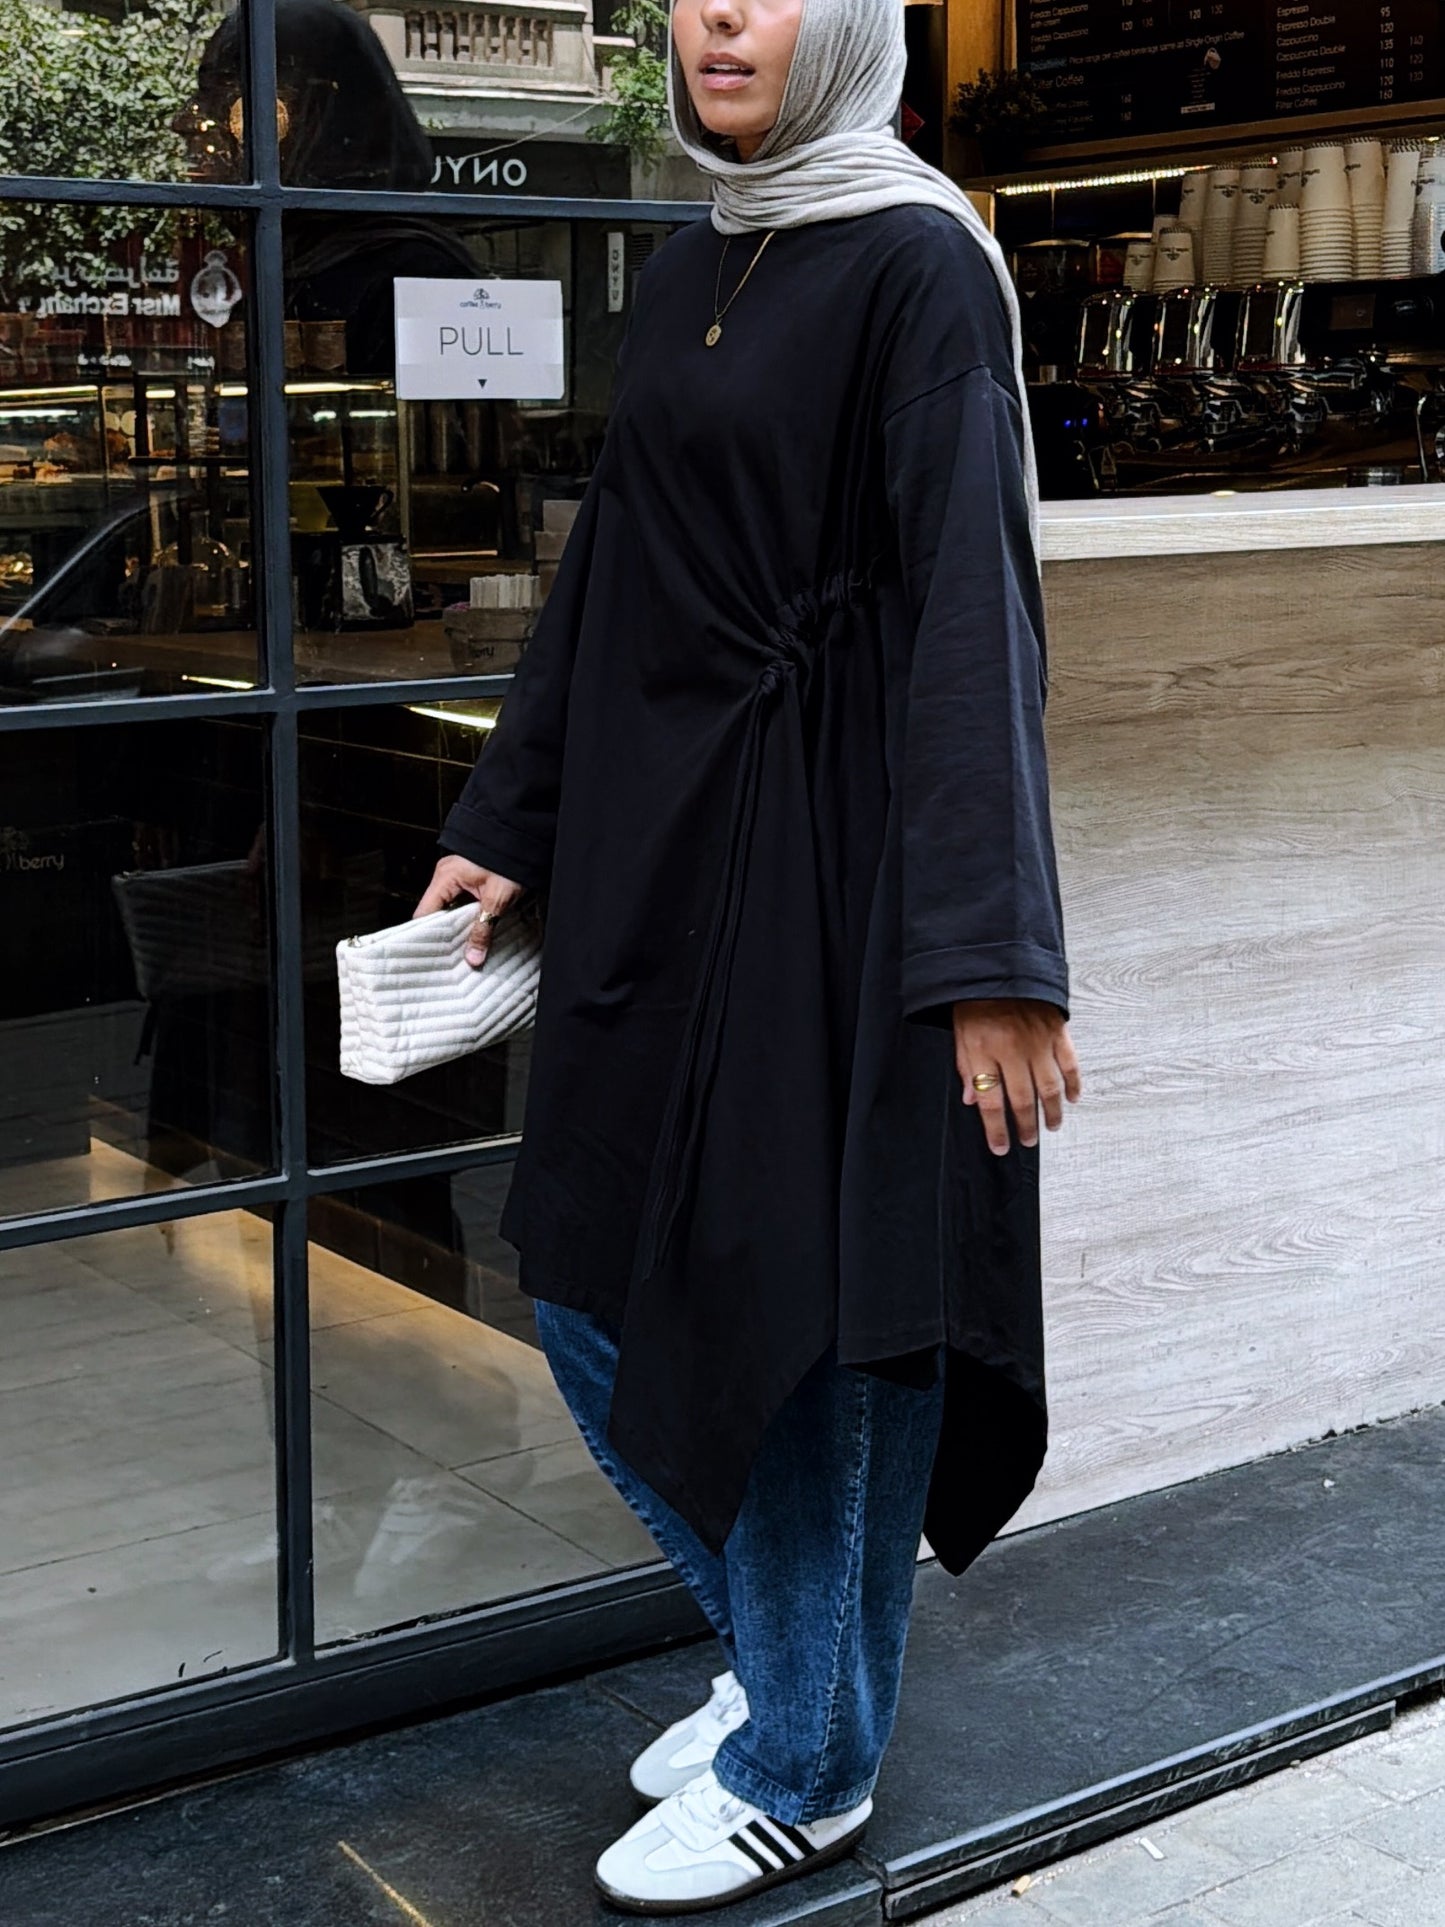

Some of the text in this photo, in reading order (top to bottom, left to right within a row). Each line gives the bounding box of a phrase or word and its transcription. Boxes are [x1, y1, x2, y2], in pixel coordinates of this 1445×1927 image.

[1380, 6, 1391, 17] 95
[1380, 22, 1394, 33] 120
[1302, 80, 1346, 93] Cappuccino
[439, 326, 525, 356] PULL
[18, 853, 65, 872] berry
